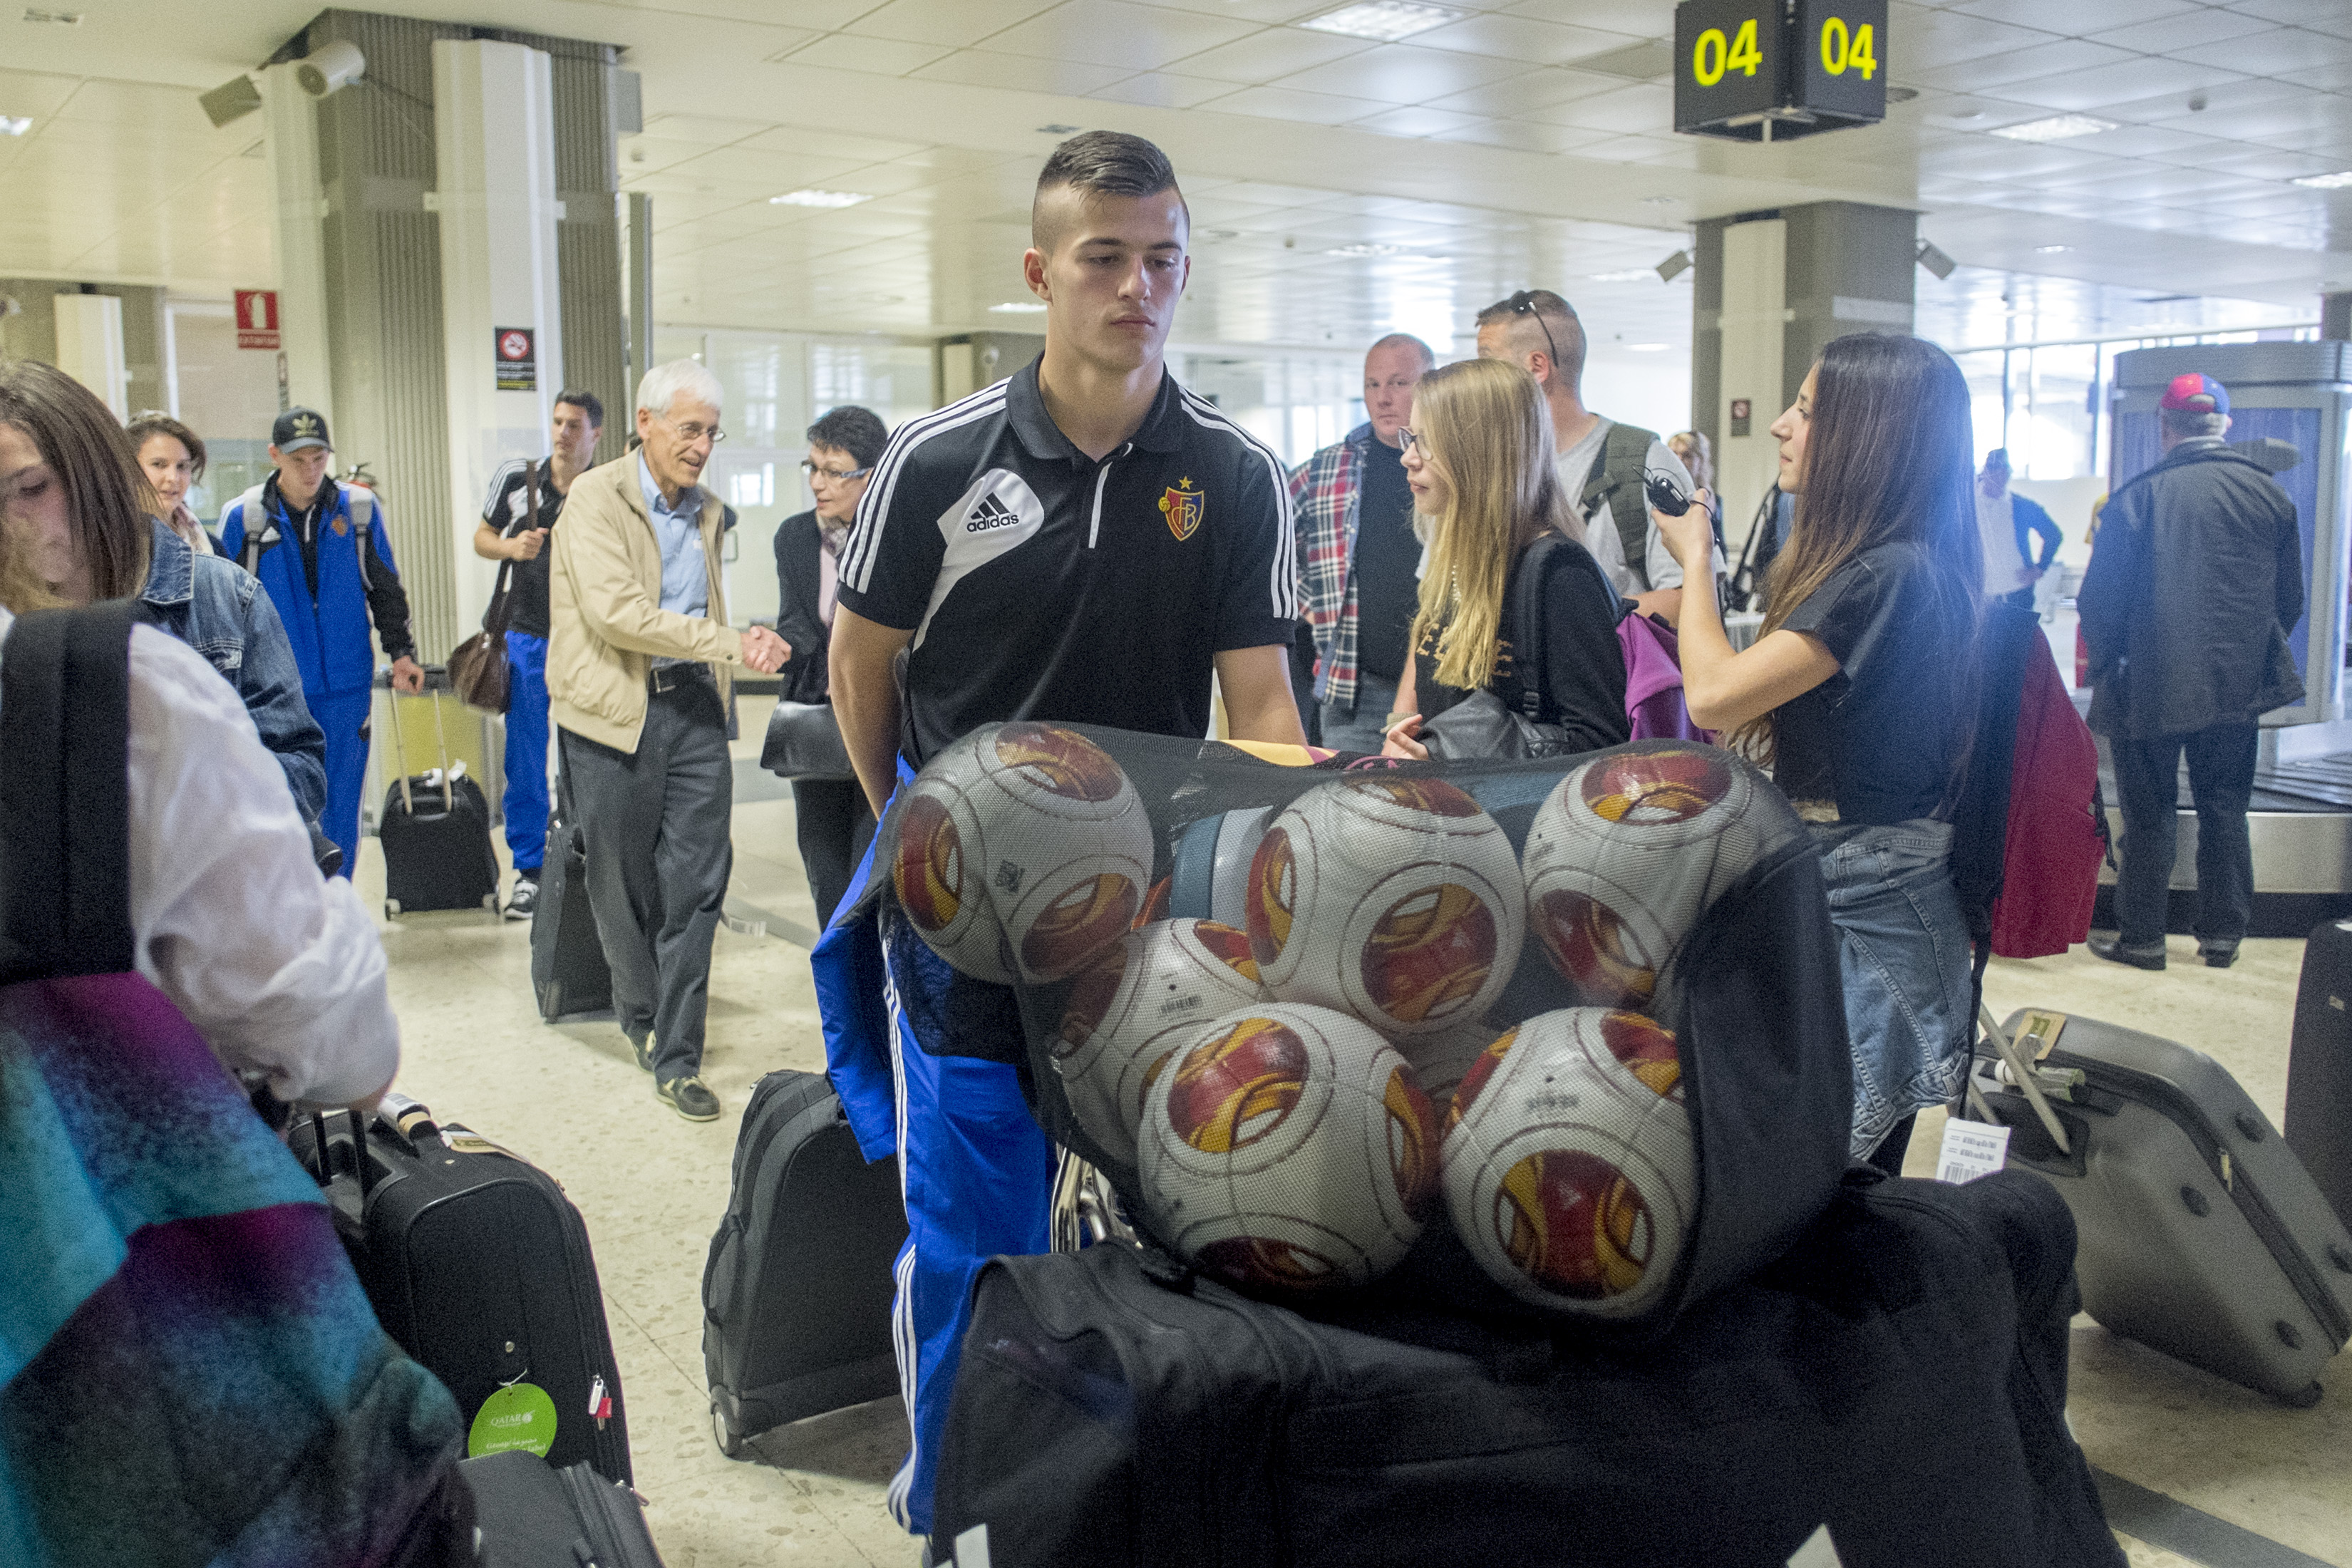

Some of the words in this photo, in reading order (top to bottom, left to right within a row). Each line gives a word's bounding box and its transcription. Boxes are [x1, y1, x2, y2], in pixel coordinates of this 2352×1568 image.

[1693, 19, 1763, 86] 04
[1820, 16, 1877, 81] 04
[966, 514, 1019, 532] adidas
[490, 1413, 521, 1426] QATAR
